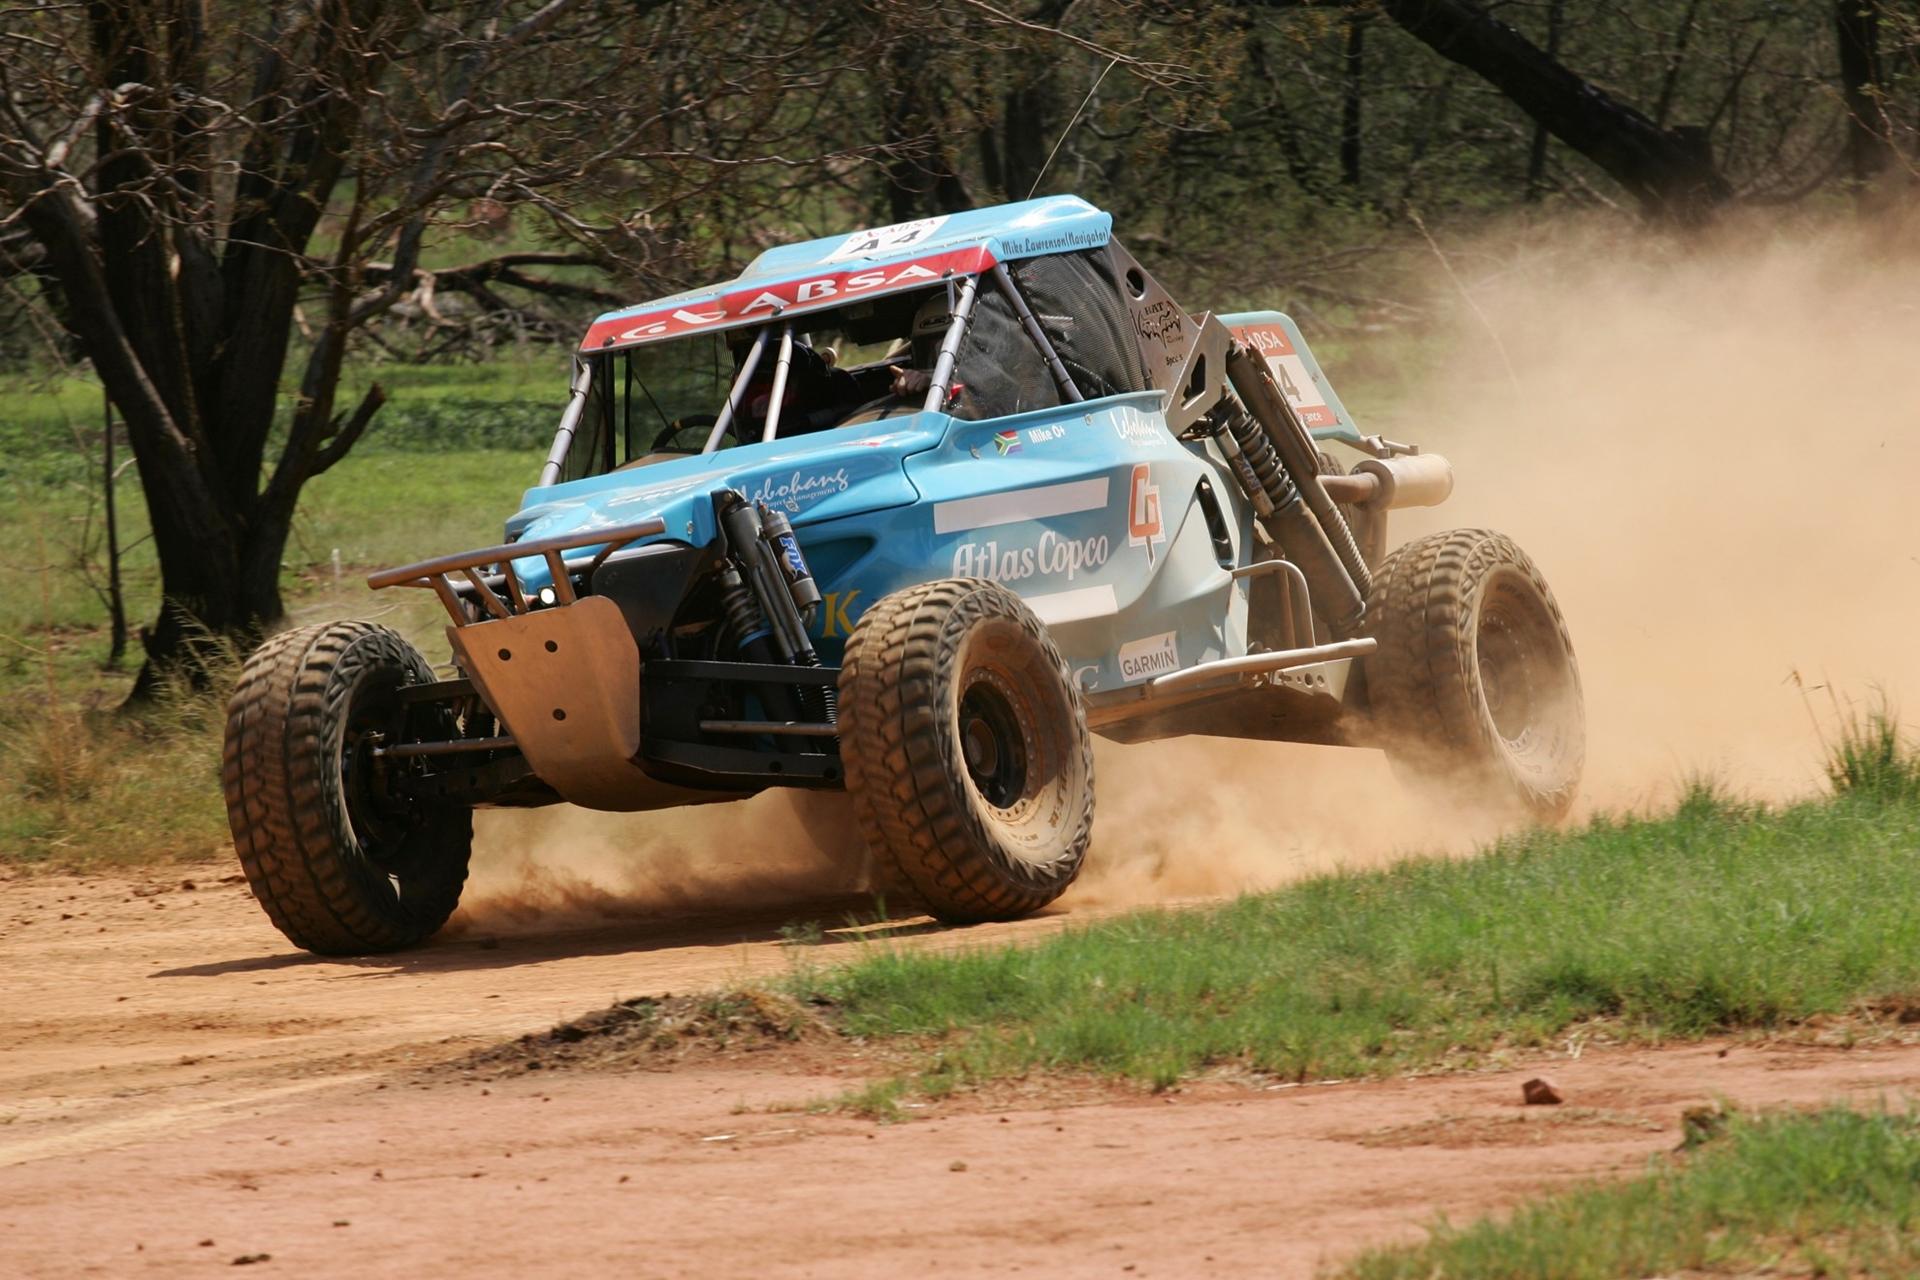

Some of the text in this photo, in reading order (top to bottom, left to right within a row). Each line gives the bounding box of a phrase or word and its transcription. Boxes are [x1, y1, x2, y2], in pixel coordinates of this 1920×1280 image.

[1002, 238, 1023, 256] Mike
[740, 264, 938, 314] ABSA
[1028, 427, 1053, 444] Mike
[953, 530, 1109, 581] Atlas Copco
[1122, 648, 1175, 677] GARMIN
